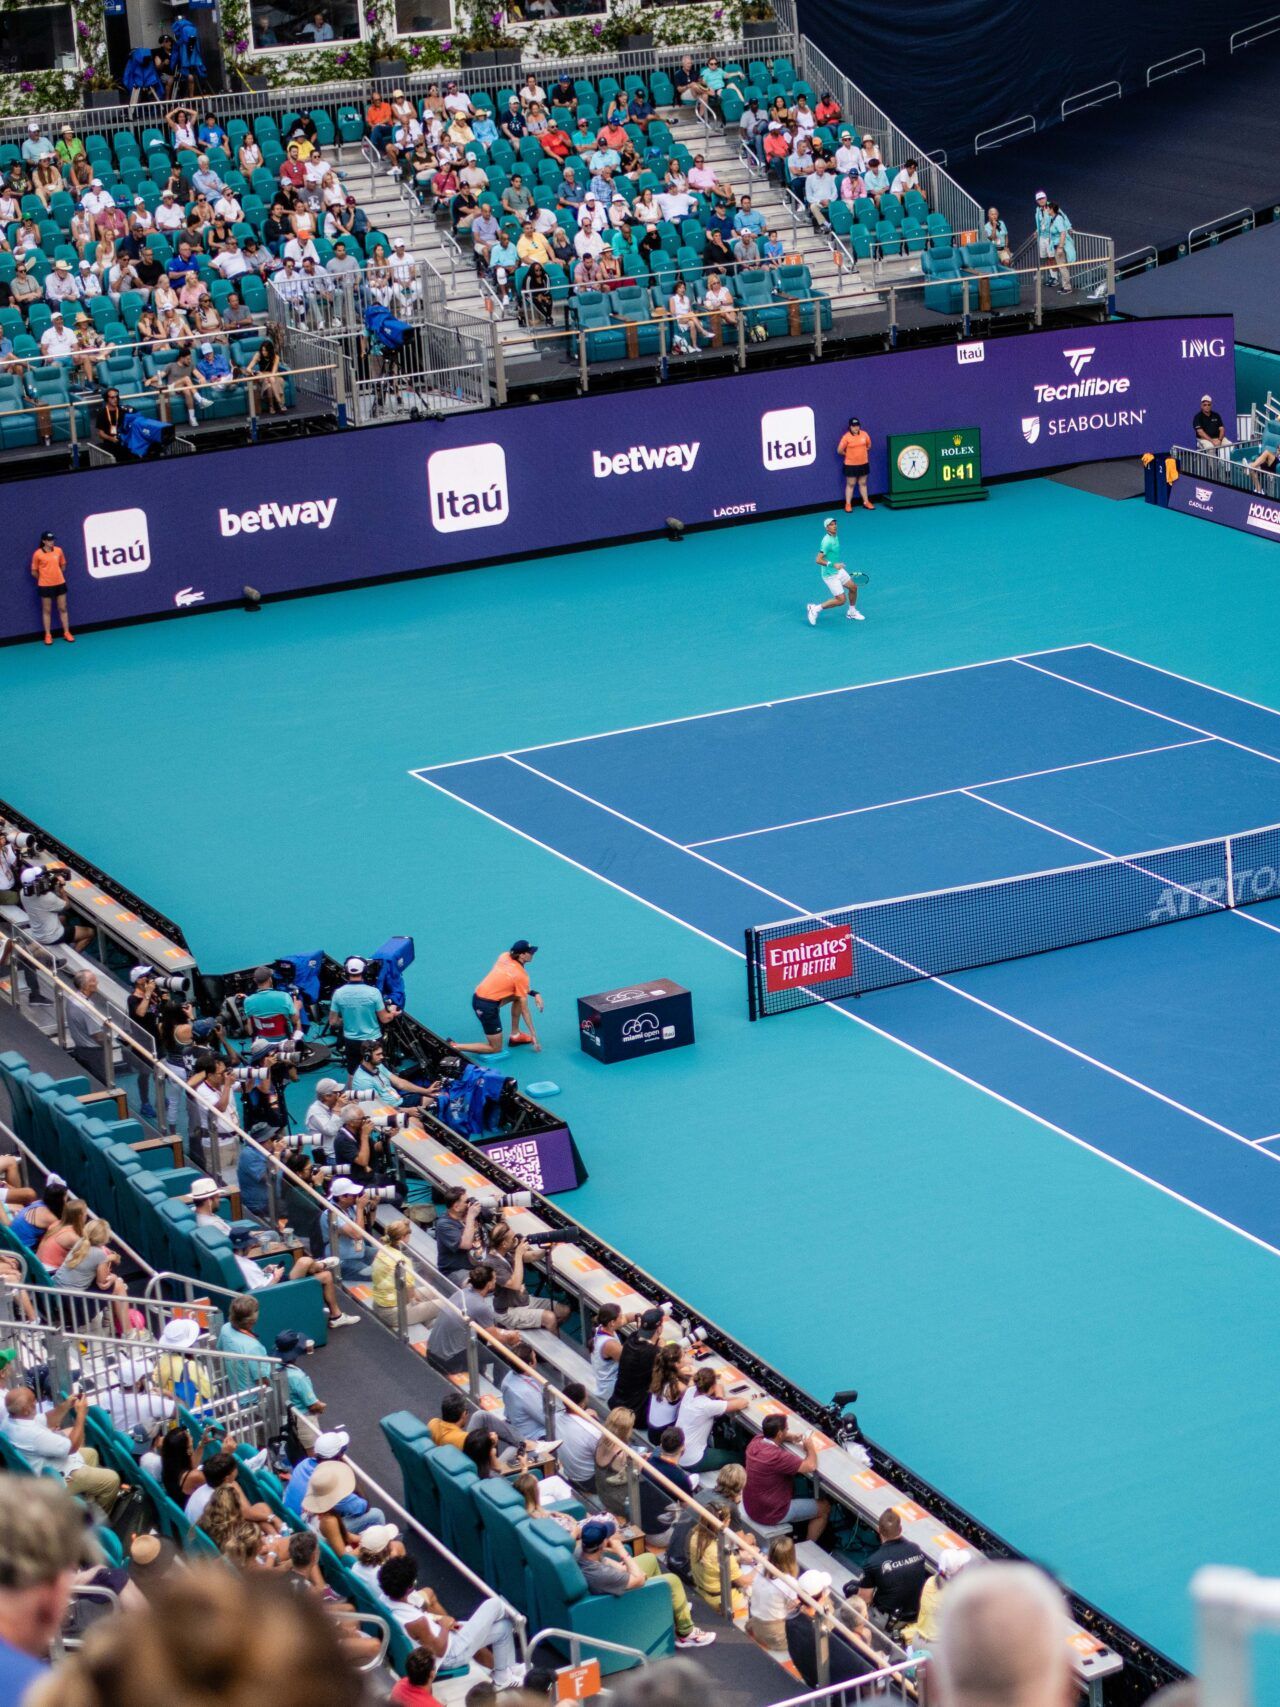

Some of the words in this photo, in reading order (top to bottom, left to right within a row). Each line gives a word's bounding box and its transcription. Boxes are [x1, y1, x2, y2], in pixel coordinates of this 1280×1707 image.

[958, 346, 983, 362] Itaú
[1181, 338, 1226, 359] IMG
[1033, 376, 1131, 404] Tecnifibre
[1047, 411, 1144, 436] SEABOURN
[591, 441, 701, 479] betway
[767, 435, 812, 462] Itaú
[940, 446, 975, 458] ROLEX
[942, 462, 974, 482] 0:41
[436, 483, 503, 521] Itaú
[713, 502, 757, 518] LACOSTE
[1188, 500, 1214, 513] CADILLAC
[218, 497, 338, 537] betway
[90, 540, 146, 569] Itaú
[769, 938, 848, 967] Emirates
[782, 963, 800, 981] FLY
[801, 956, 837, 977] BETTER
[622, 1032, 644, 1043] miami
[644, 1029, 660, 1039] open
[575, 1675, 584, 1697] F
